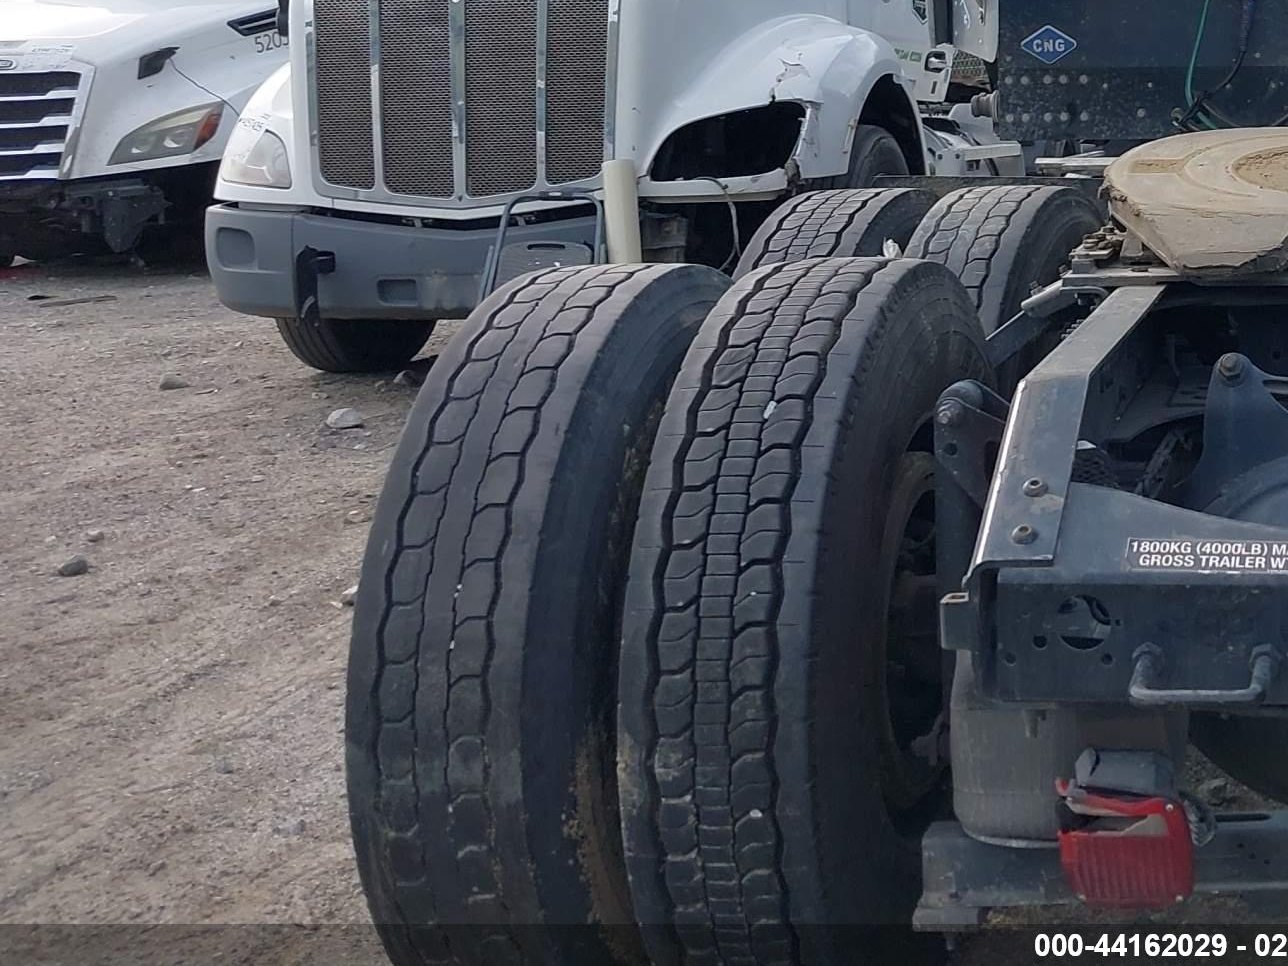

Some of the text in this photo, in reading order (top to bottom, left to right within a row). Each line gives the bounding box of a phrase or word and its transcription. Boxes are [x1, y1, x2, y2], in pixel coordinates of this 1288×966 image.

[1033, 38, 1065, 52] CNG
[1130, 541, 1192, 554] 1800KG
[1196, 542, 1268, 556] (4000LB)
[1139, 554, 1195, 567] GROSS
[1200, 556, 1266, 569] TRAILER
